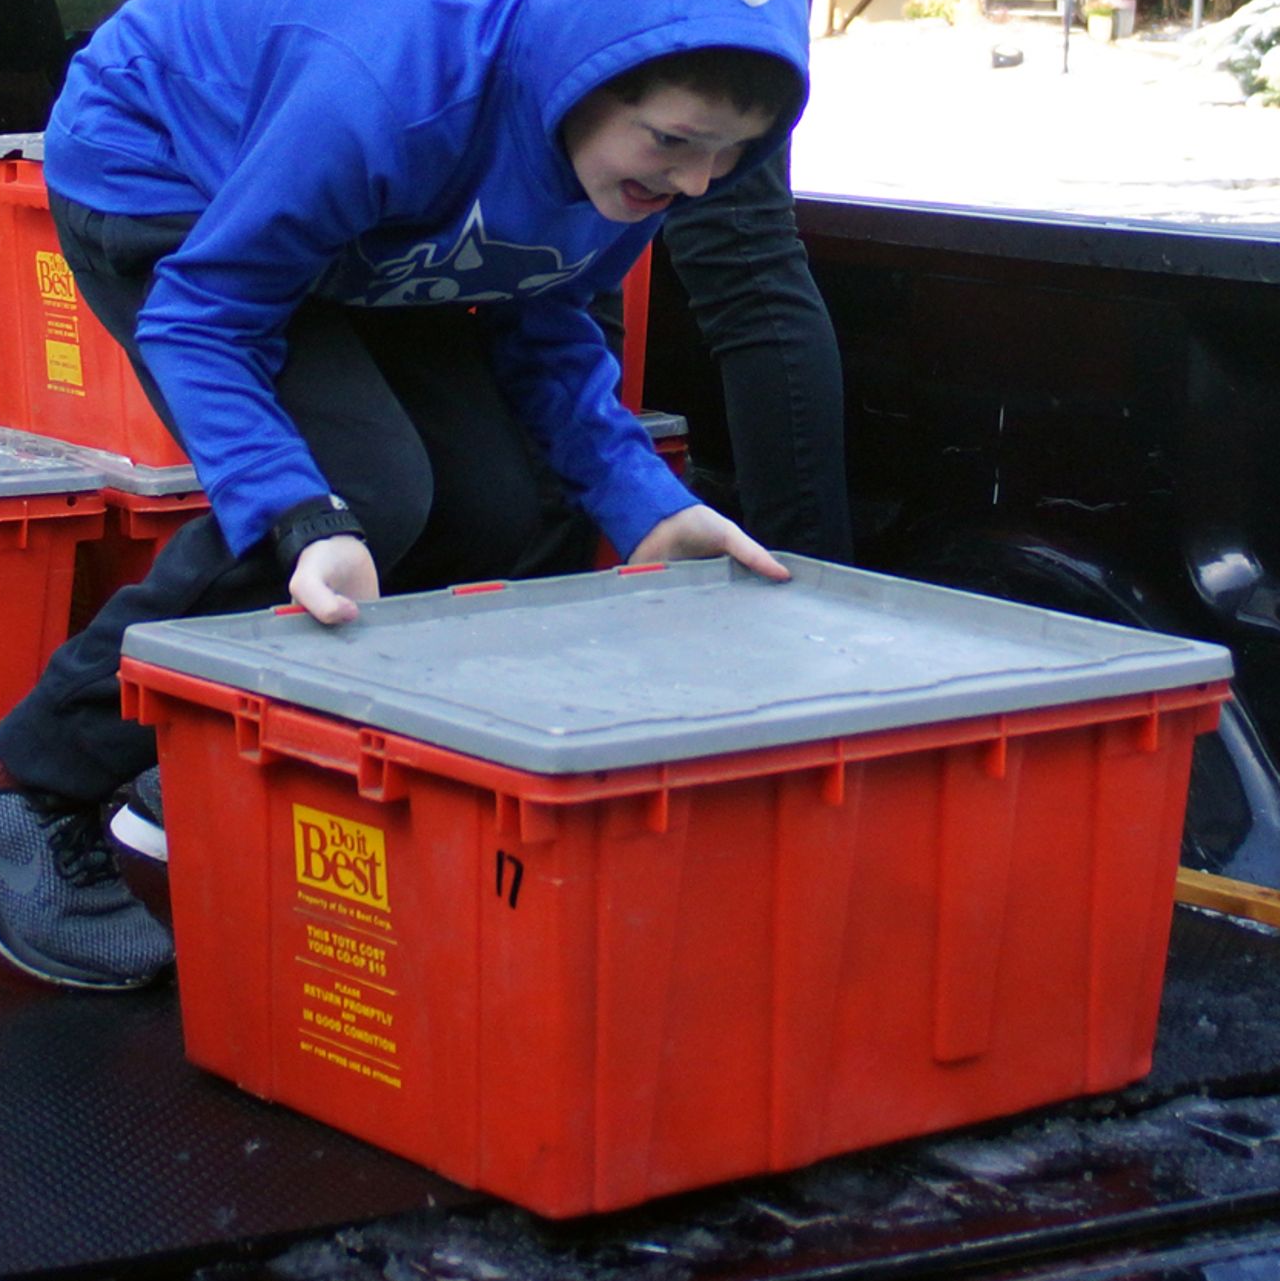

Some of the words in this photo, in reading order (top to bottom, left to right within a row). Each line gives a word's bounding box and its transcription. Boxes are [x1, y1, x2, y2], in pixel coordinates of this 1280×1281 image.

[328, 820, 355, 851] Do
[356, 829, 368, 856] it
[298, 819, 383, 901] Best
[496, 848, 524, 910] 17
[307, 924, 330, 942] THIS
[331, 933, 356, 952] TOTE
[359, 942, 385, 961] COST
[308, 939, 334, 958] YOUR
[303, 983, 341, 1007] RETURN
[343, 998, 393, 1027] PROMPTLY
[334, 981, 361, 998] PLEASE
[303, 1007, 314, 1022] IN
[315, 1012, 342, 1033] GOOD
[343, 1023, 396, 1053] CONDITION
